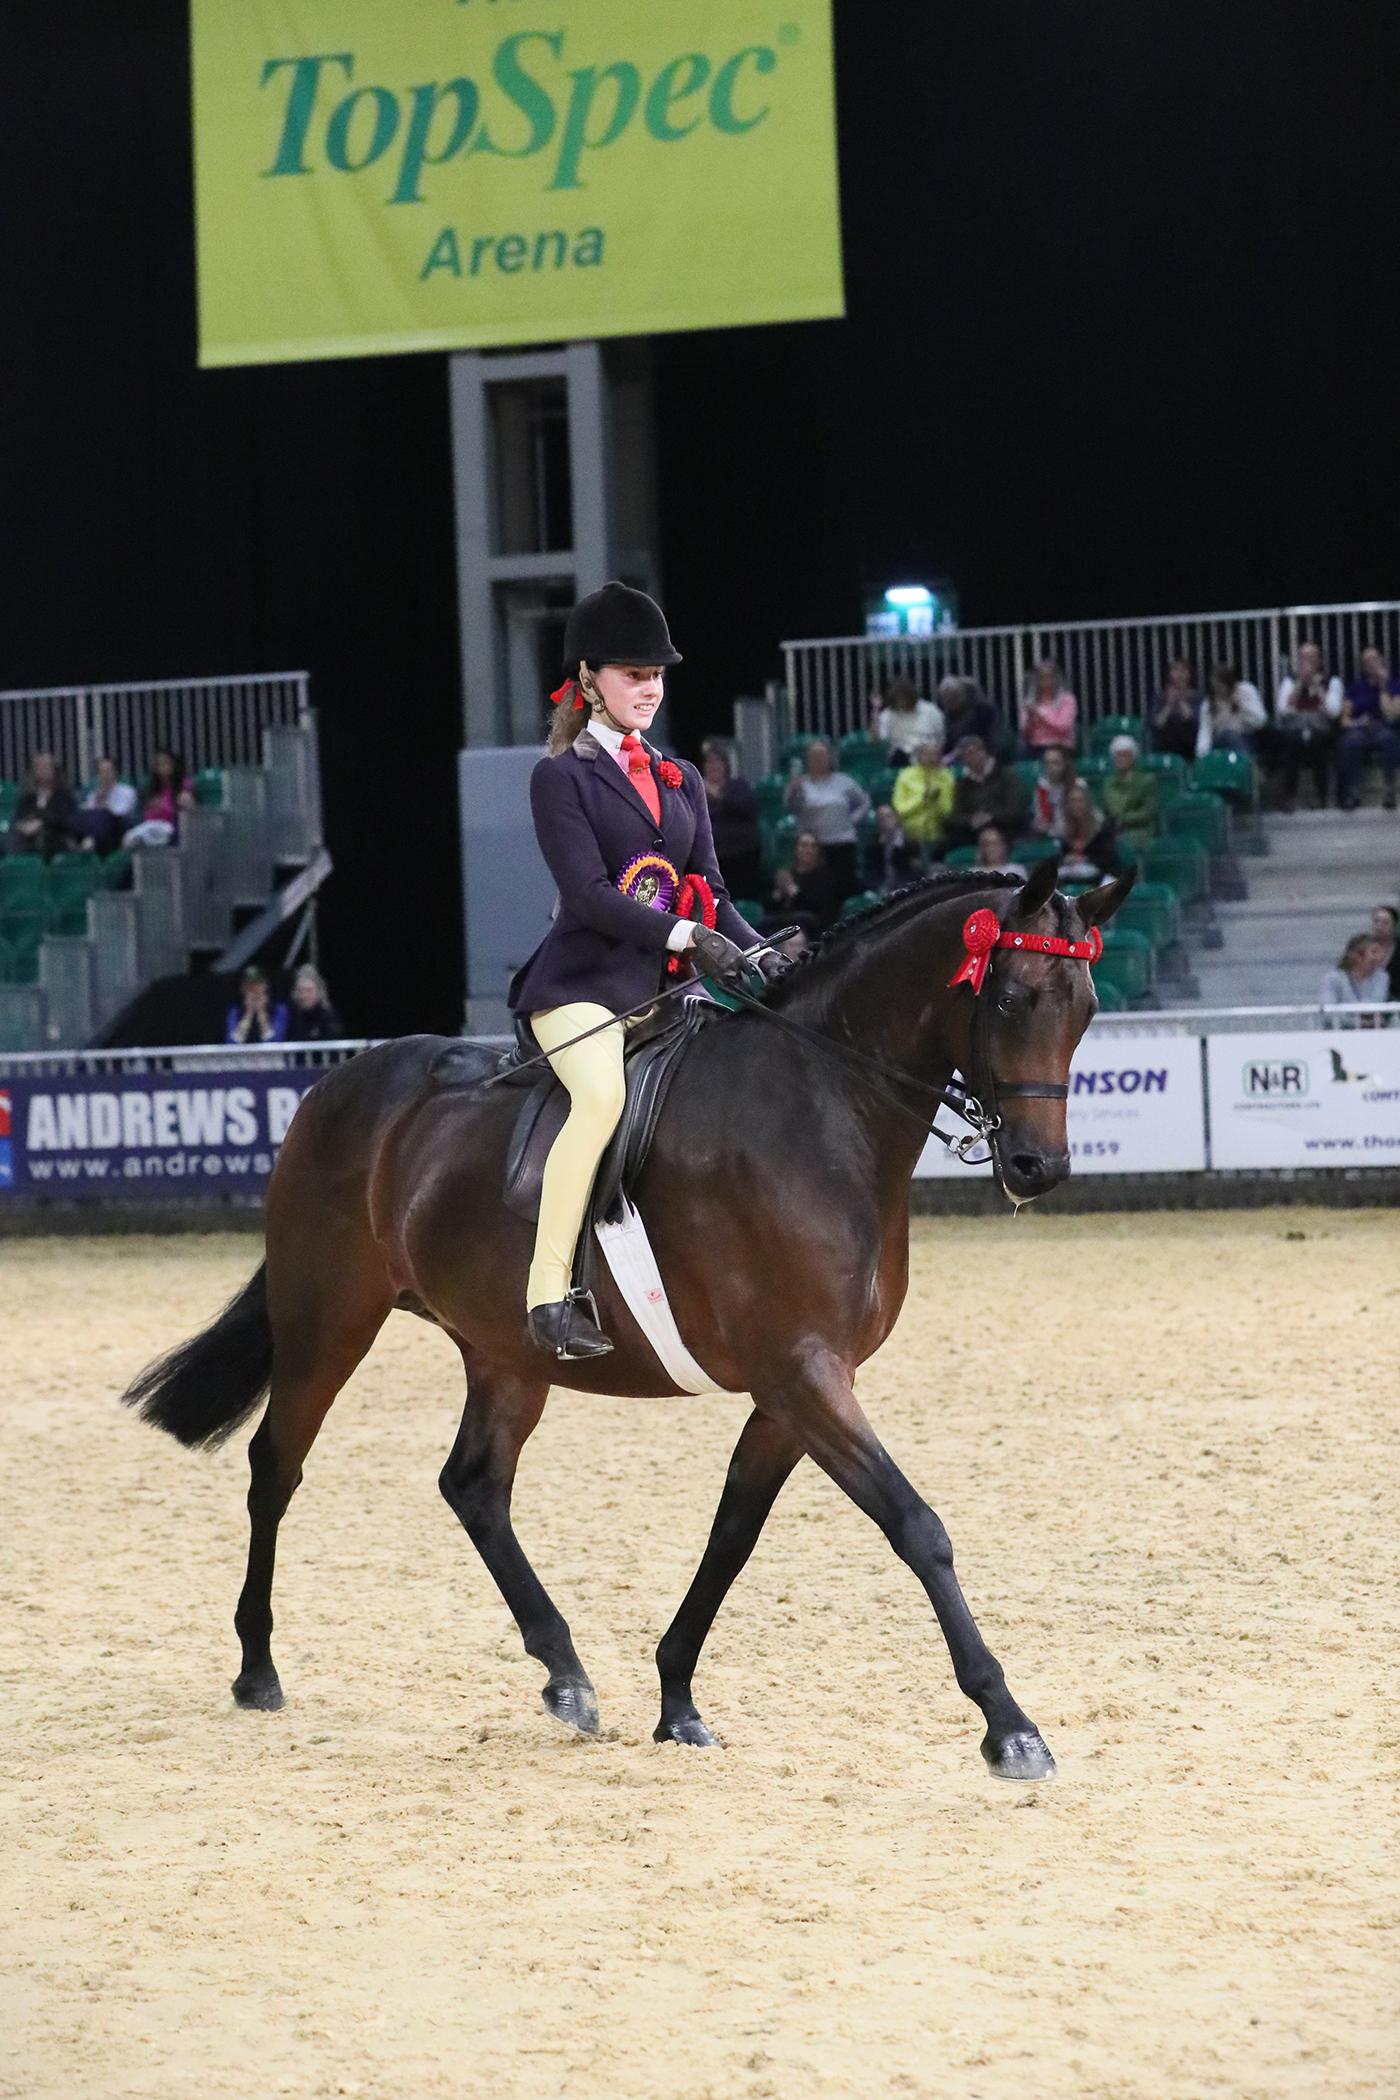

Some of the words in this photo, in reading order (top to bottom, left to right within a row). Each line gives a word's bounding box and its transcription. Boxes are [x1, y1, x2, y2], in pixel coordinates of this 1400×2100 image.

[420, 226, 604, 281] Arena
[1069, 1070, 1167, 1094] NSON
[1250, 1065, 1301, 1091] N&R
[27, 1087, 258, 1150] ANDREWS
[28, 1149, 281, 1180] www.andrews
